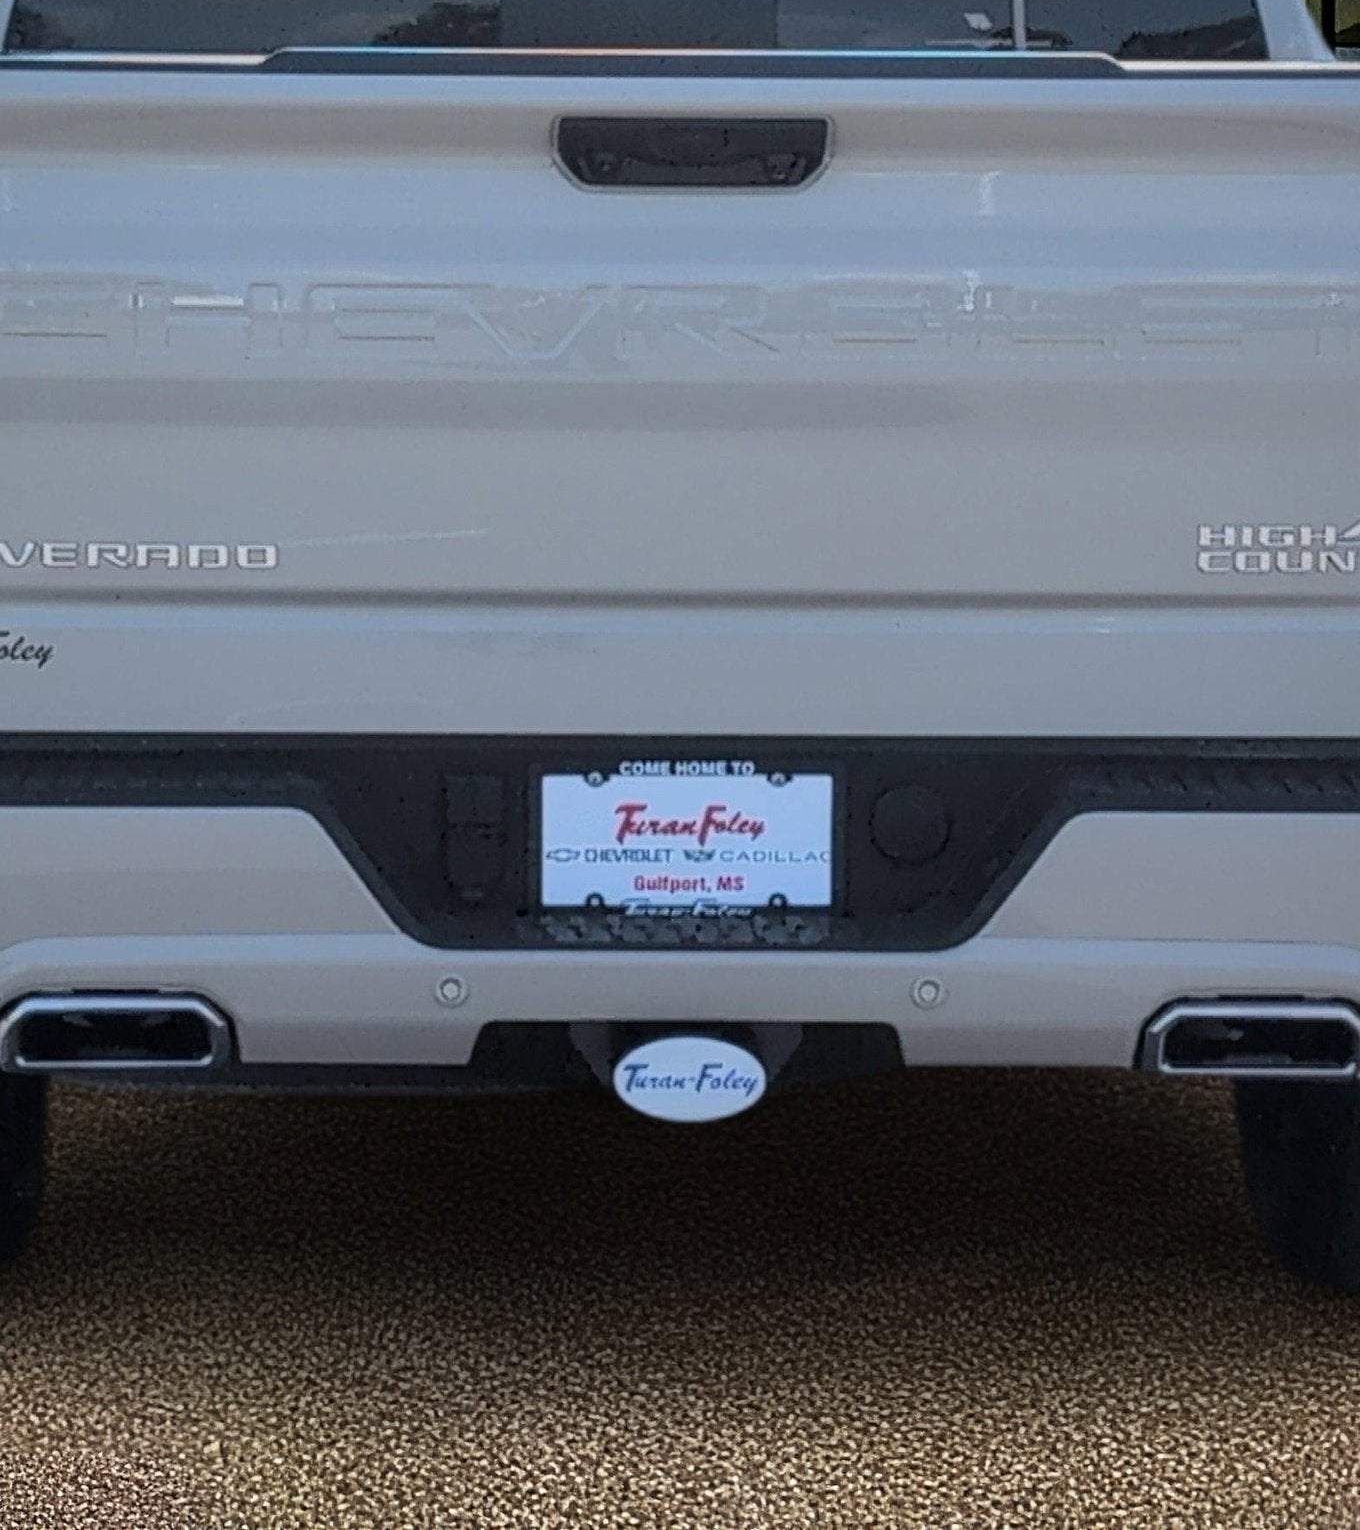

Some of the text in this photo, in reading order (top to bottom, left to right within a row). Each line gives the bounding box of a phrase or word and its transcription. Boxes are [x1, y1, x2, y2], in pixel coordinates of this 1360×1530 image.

[1196, 524, 1338, 547] HIGH
[619, 759, 755, 775] COME HOME TO
[583, 848, 831, 864] CHEVROLET CADILLAC
[633, 875, 744, 895] Gulfport, MS
